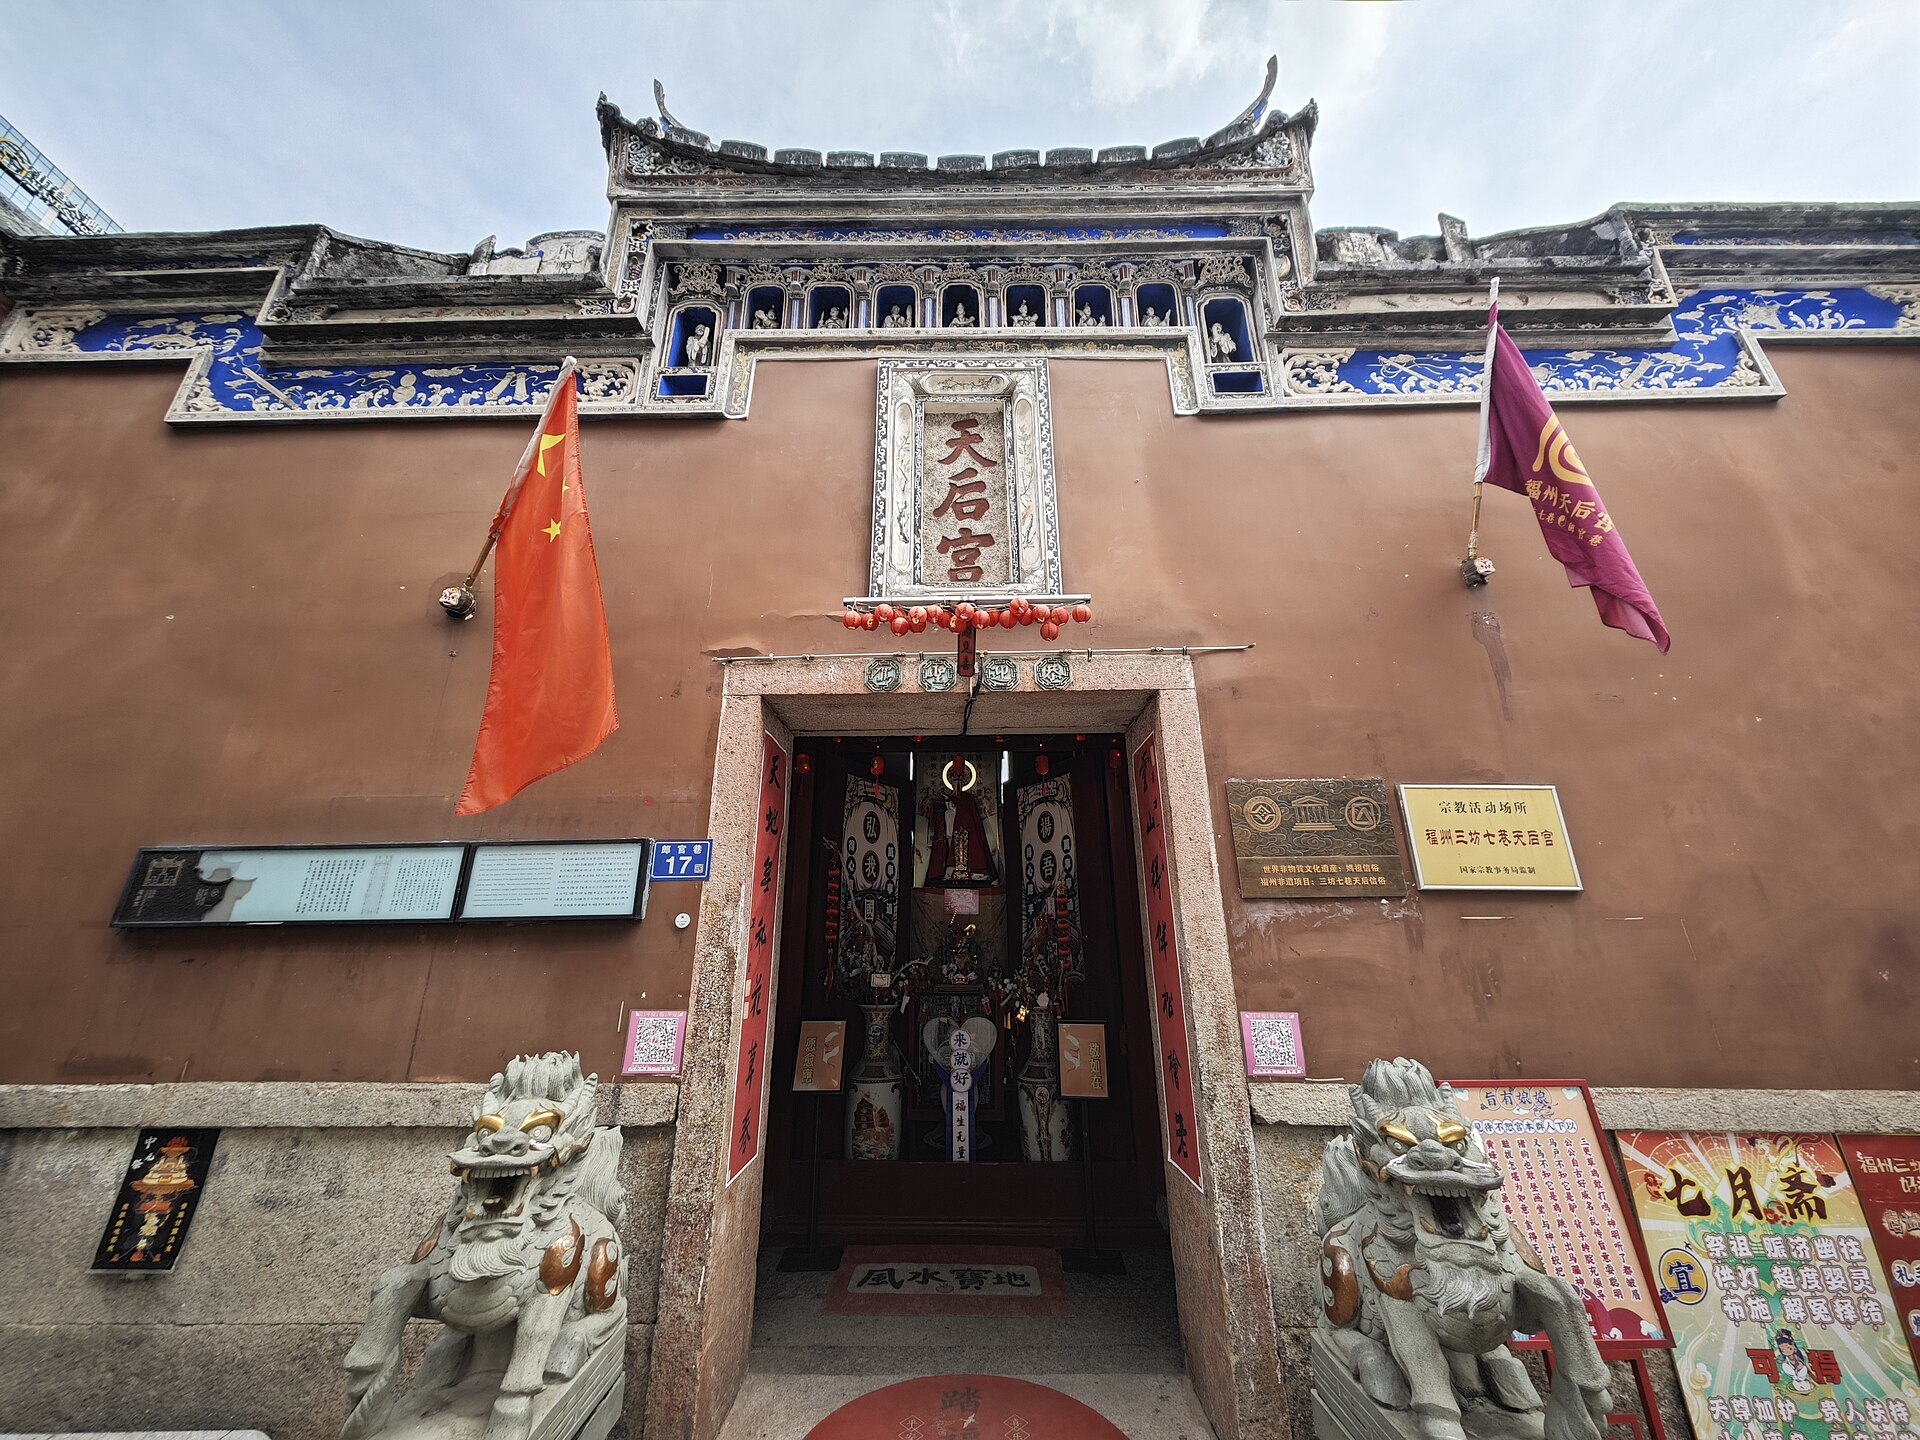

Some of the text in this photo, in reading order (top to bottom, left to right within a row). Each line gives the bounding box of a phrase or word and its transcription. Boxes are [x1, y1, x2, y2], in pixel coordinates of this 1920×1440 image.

[1438, 800, 1527, 815] 宗教活动场所
[1425, 828, 1554, 847] 福州三坊七巷天后宫
[666, 856, 692, 874] 17
[1459, 865, 1537, 876] 国家宗教事务局监制
[953, 1032, 970, 1087] 来就好
[1664, 1166, 1828, 1222] 七月斋
[1899, 1176, 1920, 1193] 好
[1705, 1234, 1754, 1259] 祭祖
[1668, 1260, 1702, 1294] 宜
[1713, 1264, 1875, 1293] 供灯 超度婴灵
[1722, 1296, 1773, 1321] 布施
[1709, 1397, 1911, 1425] 天尊加护 贵人扶持
